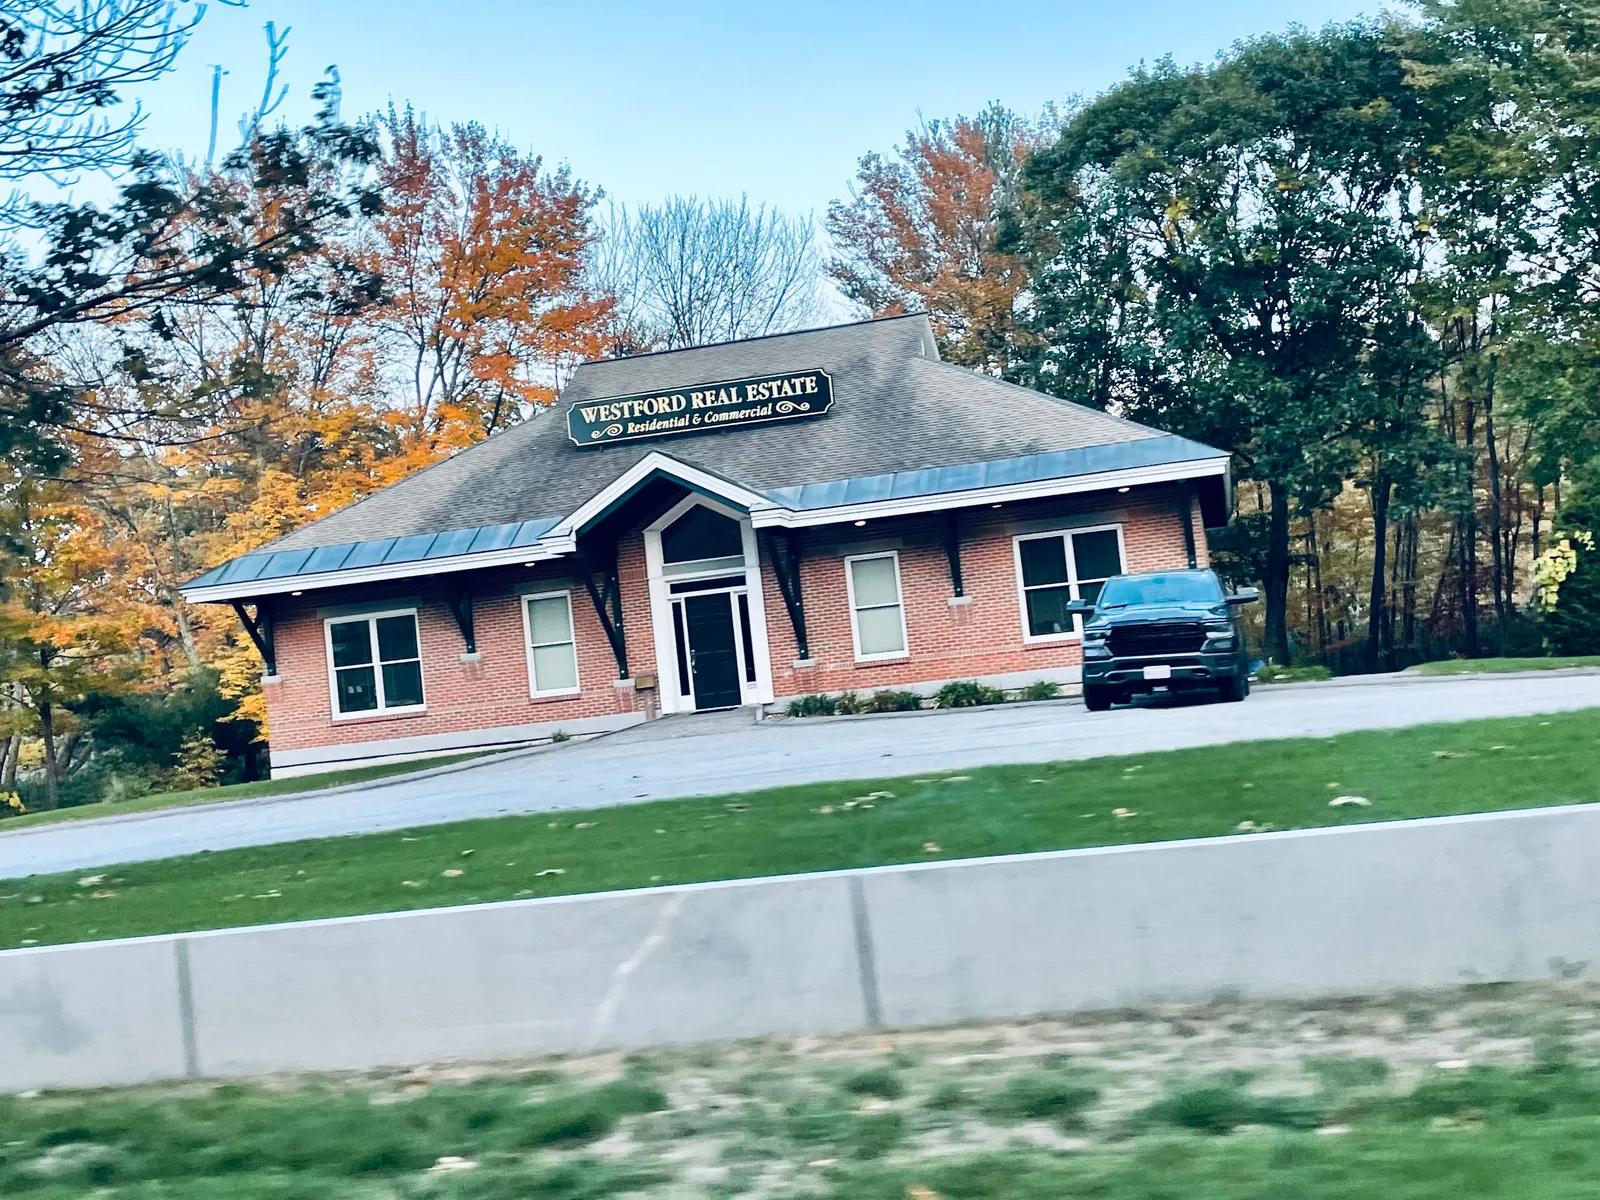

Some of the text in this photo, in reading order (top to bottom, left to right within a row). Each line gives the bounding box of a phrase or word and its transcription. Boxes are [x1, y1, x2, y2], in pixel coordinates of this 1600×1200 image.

[580, 376, 818, 424] WESTFORD REAL ESTATE
[627, 403, 773, 434] Residential & Commercial
